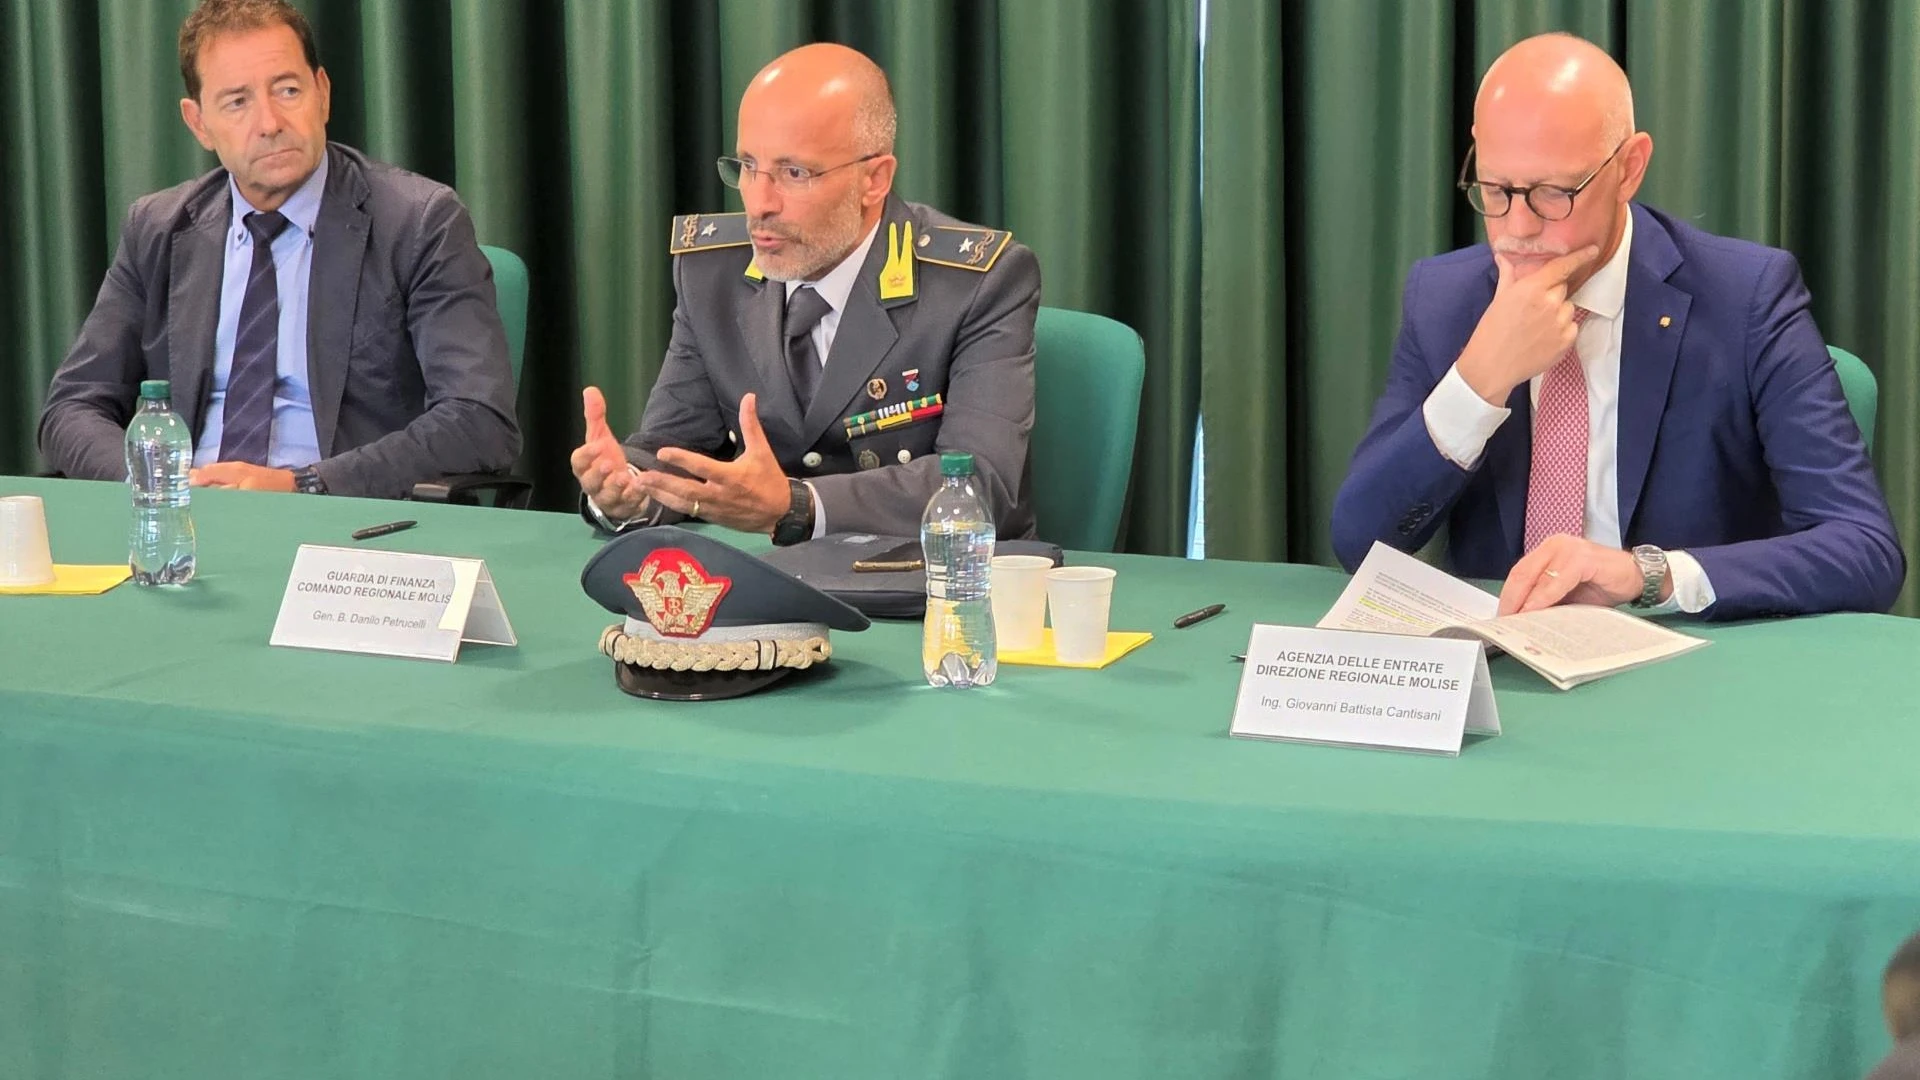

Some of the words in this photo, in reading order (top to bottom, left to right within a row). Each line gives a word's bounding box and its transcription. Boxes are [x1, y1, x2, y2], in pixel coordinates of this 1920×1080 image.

[327, 571, 375, 584] GUARDIA
[377, 575, 388, 584] DI
[389, 577, 436, 589] FINANZA
[297, 582, 352, 596] COMANDO
[353, 588, 416, 600] REGIONALE
[417, 592, 452, 604] MOLIS
[312, 610, 334, 622] Gen.
[337, 613, 348, 622] B.
[350, 614, 380, 625] Danilo
[1276, 651, 1335, 665] AGENZIA
[1338, 656, 1380, 669] DELLE
[1383, 660, 1445, 674] ENTRATE
[1256, 664, 1326, 680] DIREZIONE
[1328, 670, 1406, 687] REGIONALE
[1408, 679, 1461, 691] MOLISE
[1261, 696, 1282, 709] Ing.
[1286, 698, 1337, 712] Giovanni
[1340, 703, 1383, 716] Battista
[1386, 707, 1442, 721] Cantisani
